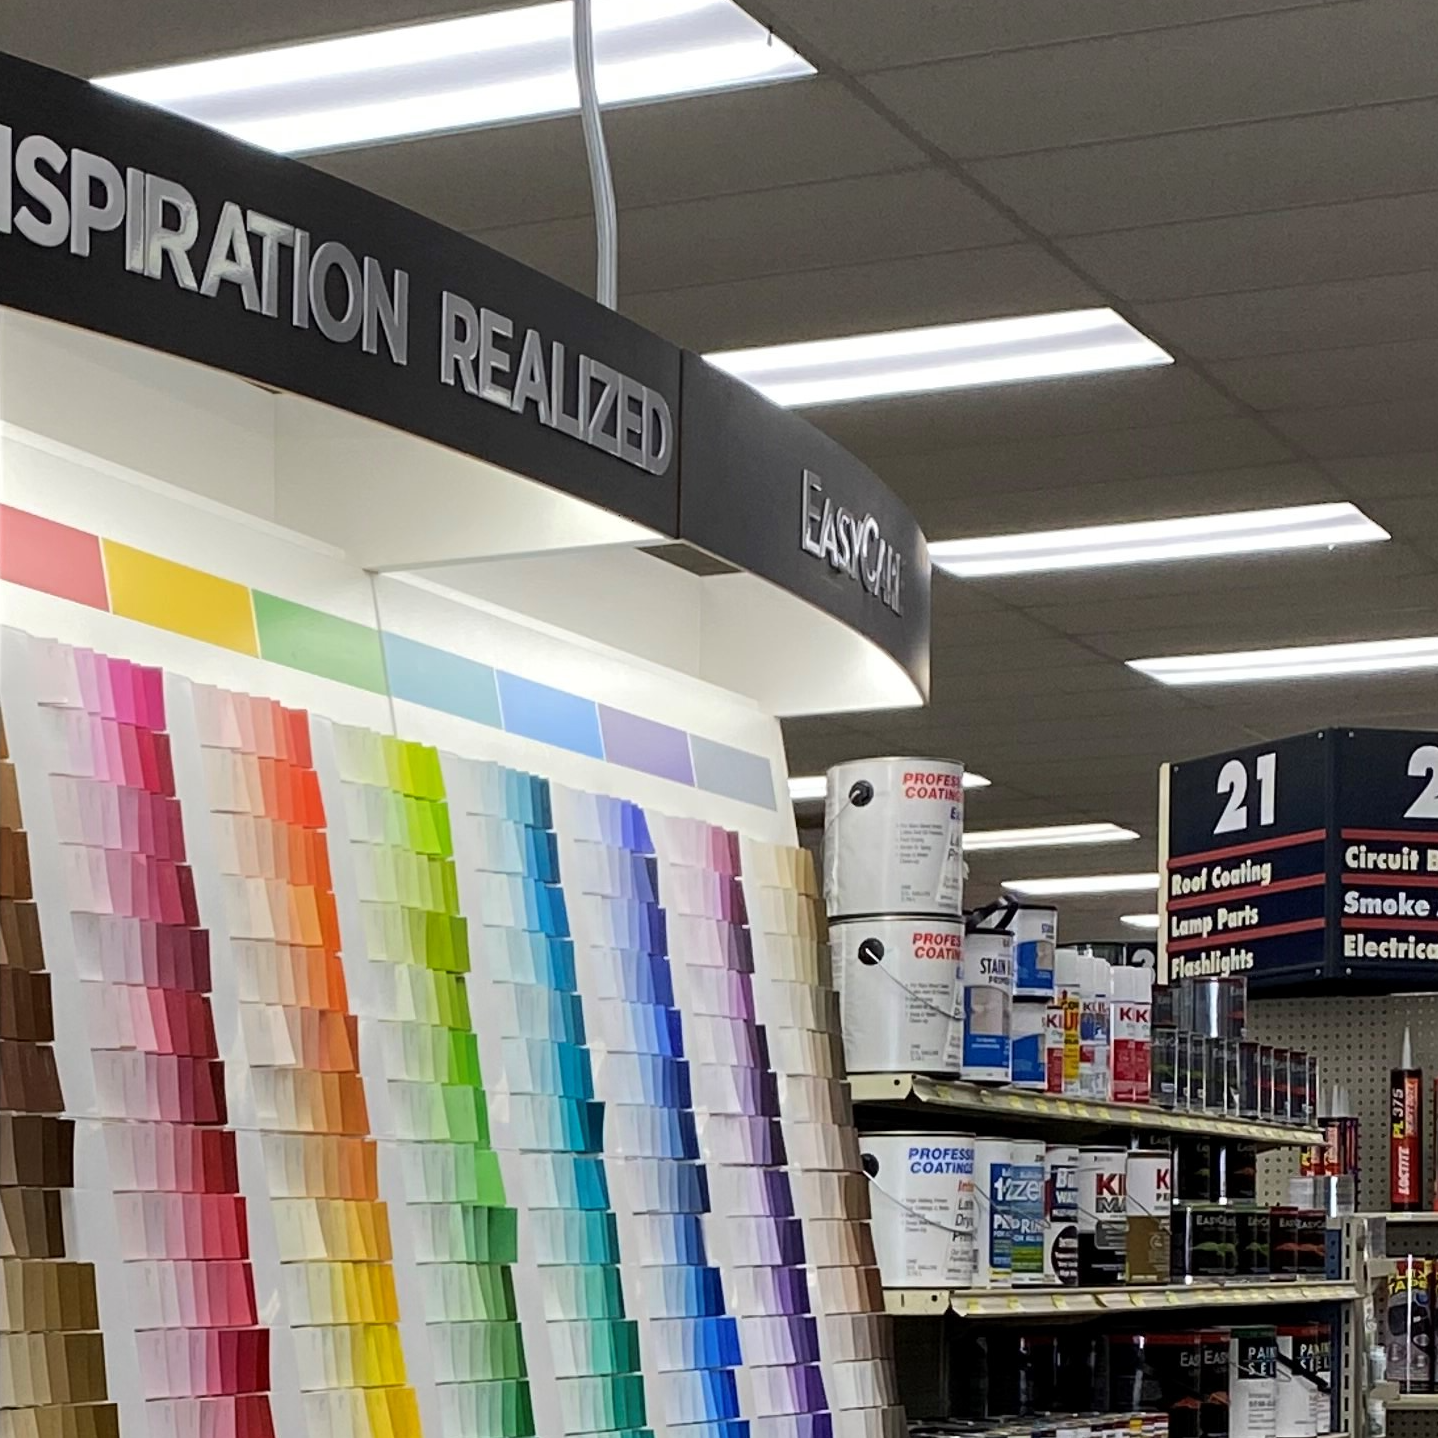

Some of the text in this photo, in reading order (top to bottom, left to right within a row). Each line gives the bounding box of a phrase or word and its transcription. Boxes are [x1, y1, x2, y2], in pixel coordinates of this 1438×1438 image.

[440, 290, 673, 476] REALIZED
[802, 468, 904, 617] EASYCAR
[1214, 752, 1276, 834] 21
[1172, 859, 1272, 896] Roof Coating
[1345, 845, 1420, 870] Circuit
[1172, 906, 1258, 938] Lamp Parts
[1344, 890, 1430, 916] Smoke
[1172, 948, 1254, 980] Flashlights
[1392, 1088, 1404, 1139] PL 375
[1398, 1146, 1410, 1195] LOCTITE
